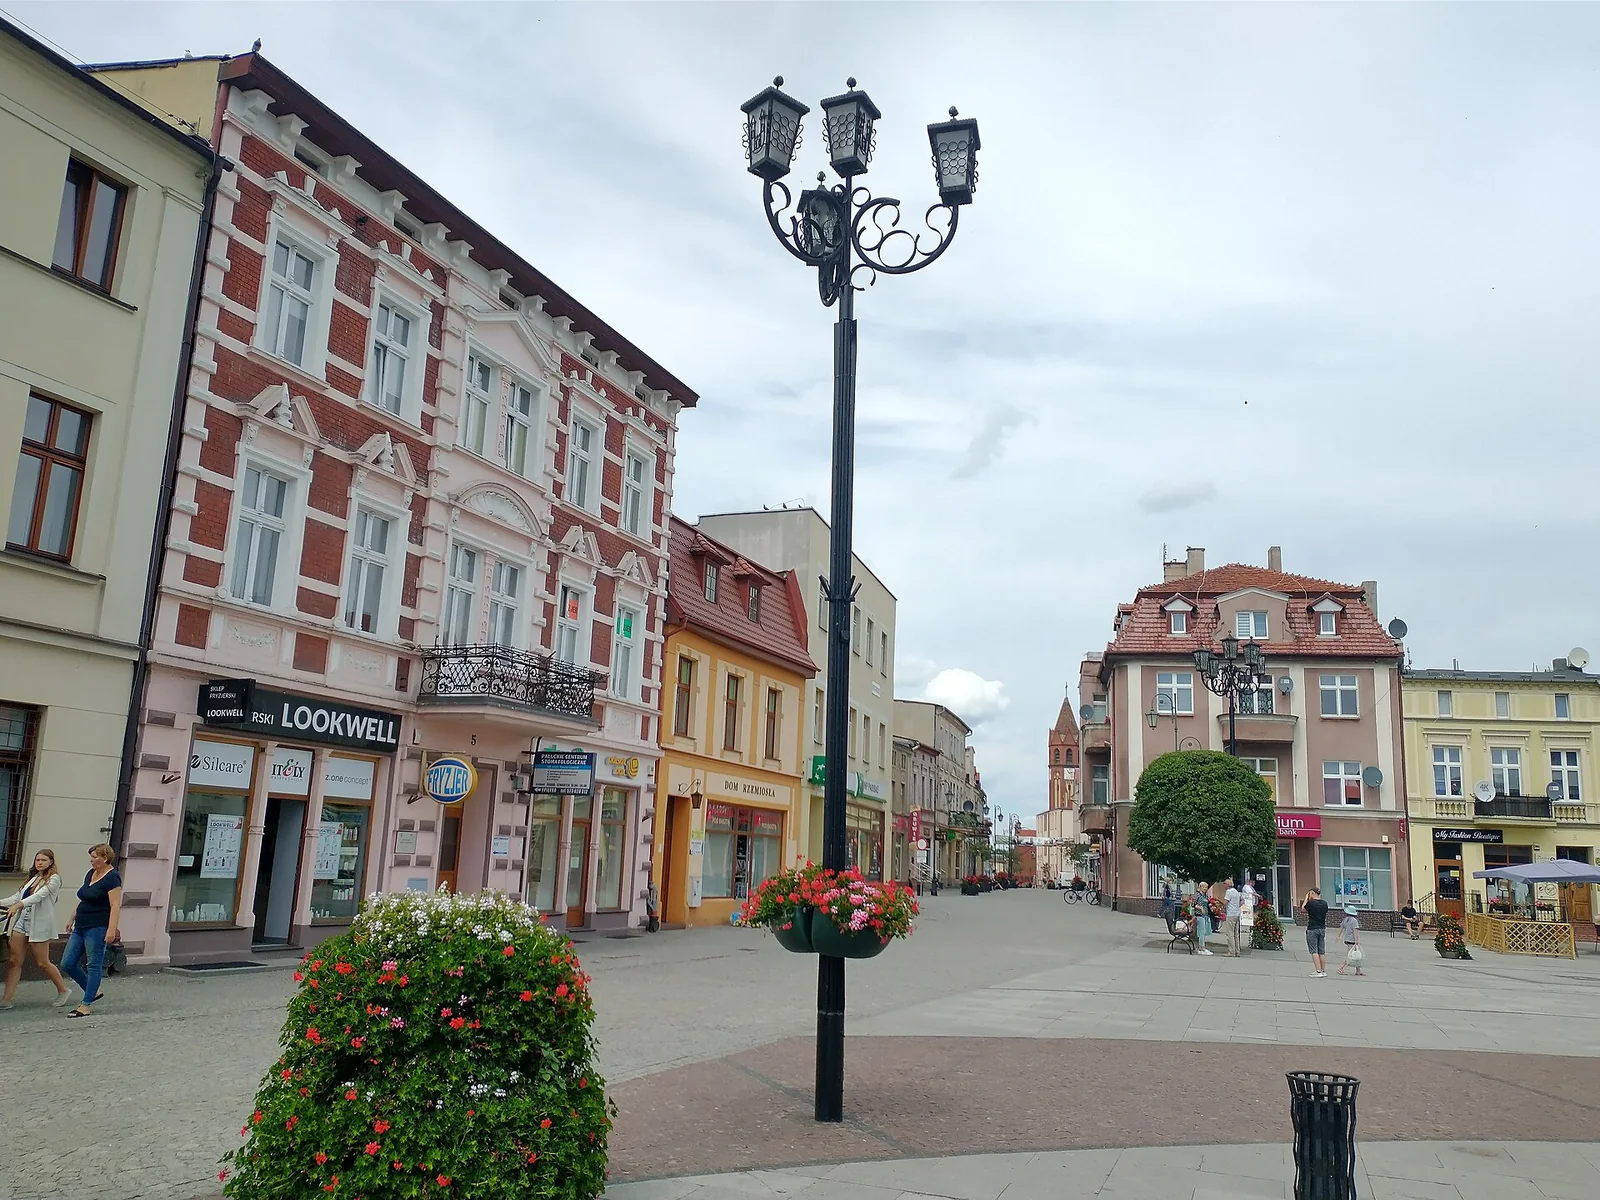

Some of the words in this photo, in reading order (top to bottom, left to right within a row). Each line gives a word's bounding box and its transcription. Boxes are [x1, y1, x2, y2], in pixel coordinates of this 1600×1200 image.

[207, 709, 244, 717] LOOKWELL
[251, 711, 275, 725] RSKI
[281, 702, 397, 744] LOOKWELL
[470, 734, 477, 746] 5
[324, 774, 344, 783] z.one
[344, 776, 369, 786] concept
[427, 767, 469, 795] FRYZJER
[724, 780, 739, 792] DOM
[742, 783, 776, 798] RZEMIOSŁA
[1448, 830, 1472, 839] Fashion
